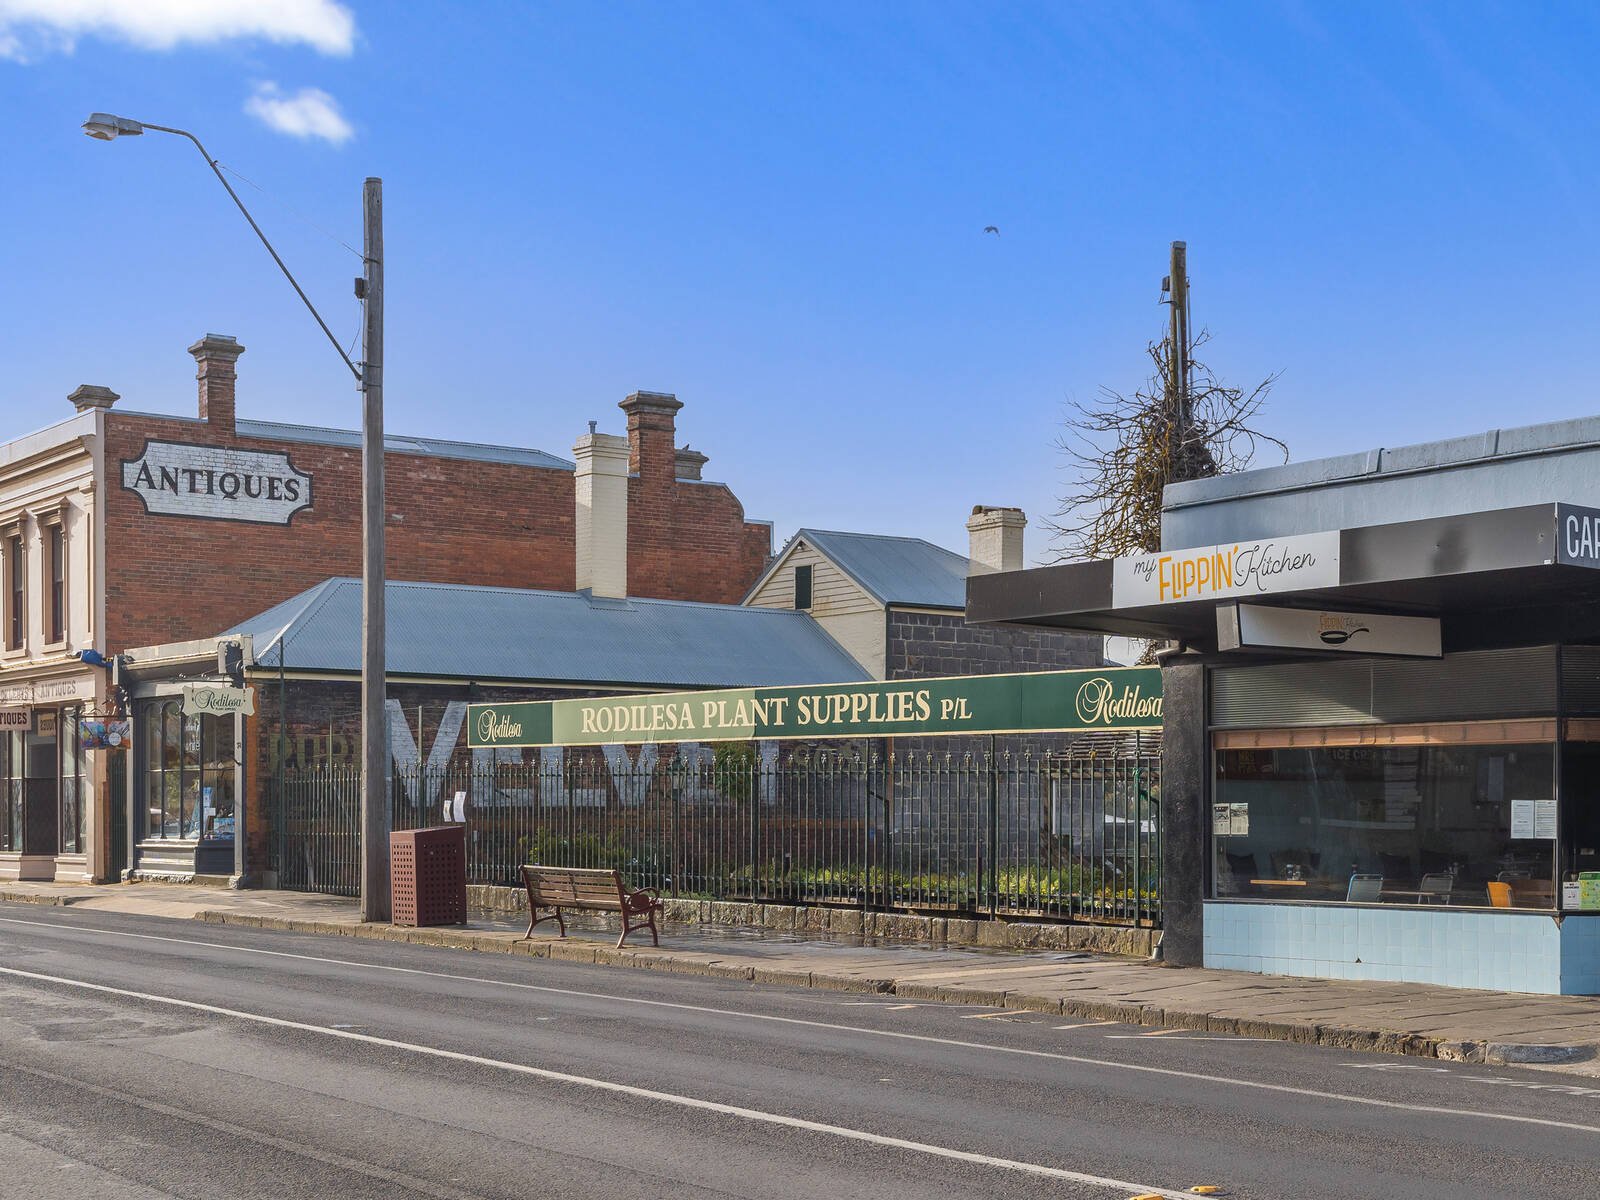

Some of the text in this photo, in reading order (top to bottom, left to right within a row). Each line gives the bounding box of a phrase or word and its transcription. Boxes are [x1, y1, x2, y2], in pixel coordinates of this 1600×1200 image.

[133, 459, 300, 502] ANTIQUES
[1133, 544, 1316, 602] my FLIPPIN' Kitchen
[40, 680, 77, 699] ANTIQUES
[581, 689, 973, 734] RODILESA PLANT SUPPLIES P/L
[1075, 677, 1163, 725] Rodilesa
[477, 708, 522, 742] Rodilesa
